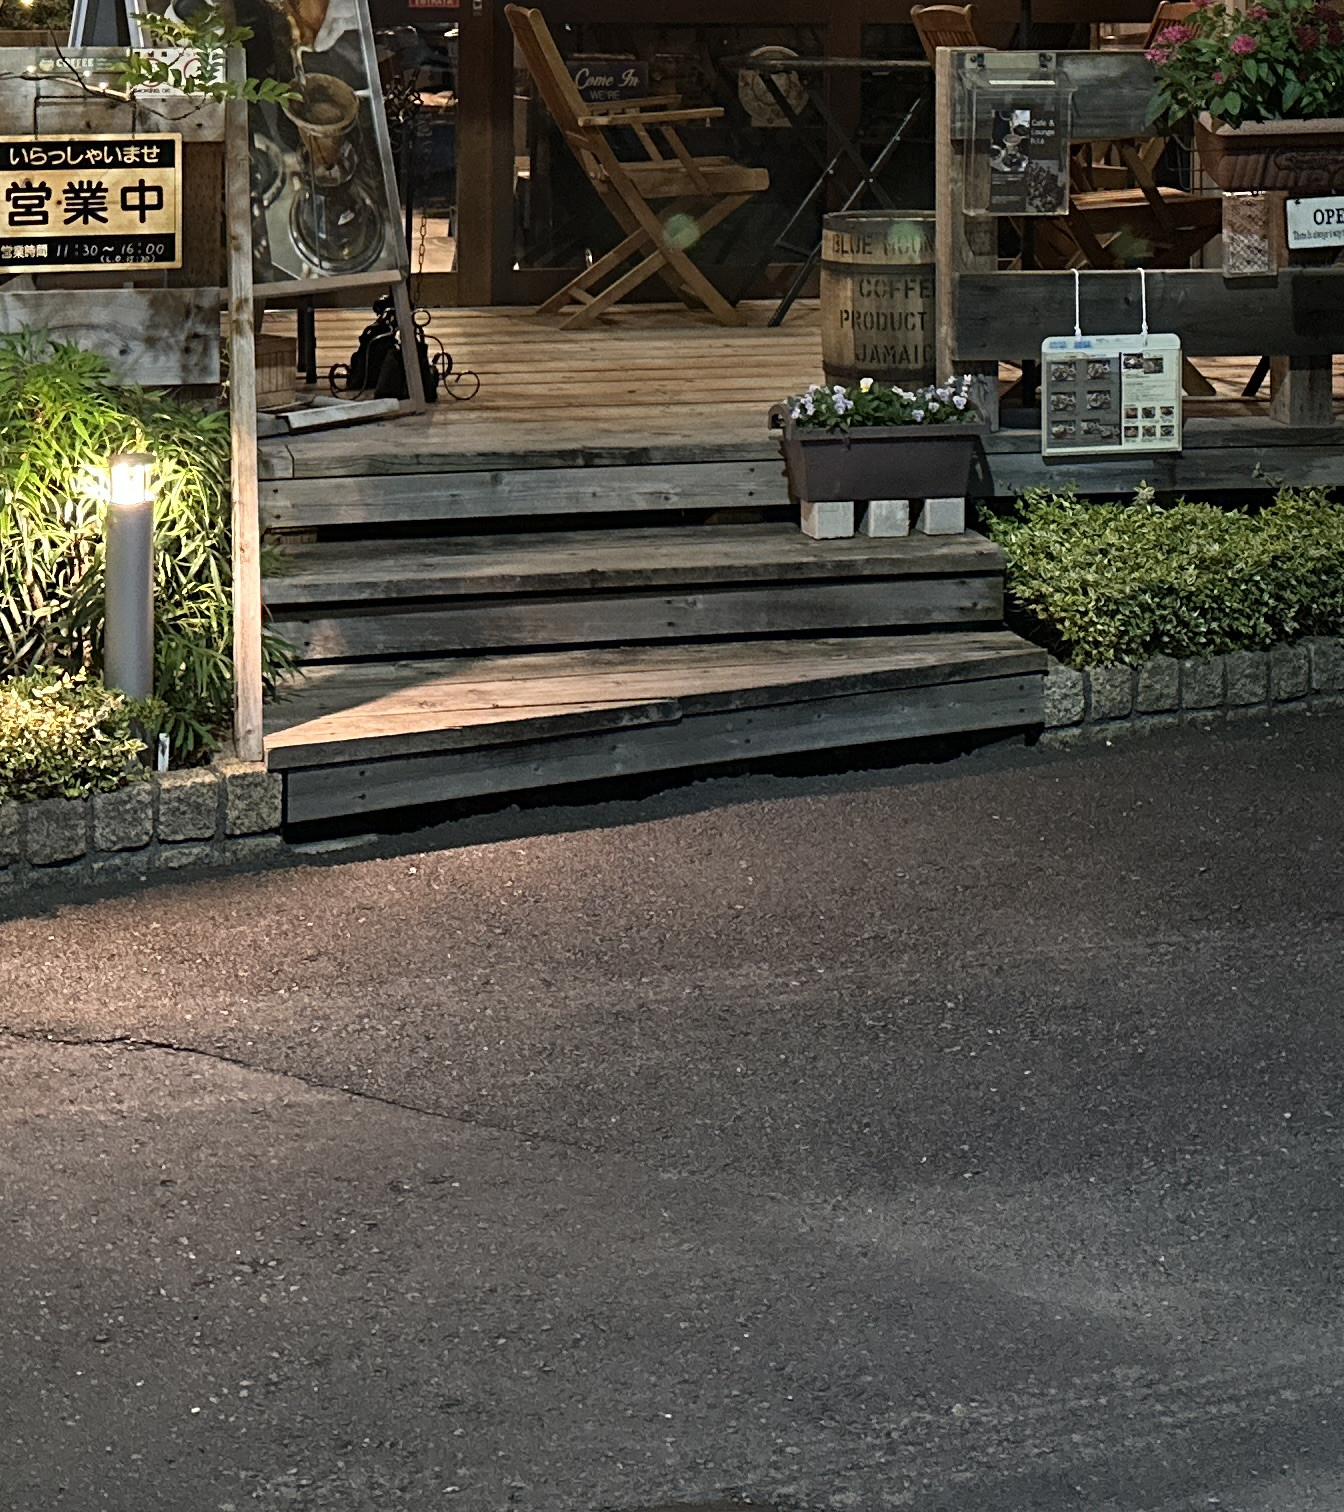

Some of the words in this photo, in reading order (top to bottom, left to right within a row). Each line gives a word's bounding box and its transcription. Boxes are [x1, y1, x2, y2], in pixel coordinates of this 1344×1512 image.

[575, 68, 615, 90] Come
[618, 69, 641, 88] In
[9, 145, 161, 165] いらっしゃいませ
[6, 178, 164, 227] 営業中
[0, 243, 48, 259] 営業時間
[832, 233, 873, 255] BLUE
[884, 233, 935, 256] MOUN
[859, 278, 935, 299] COFFE
[840, 309, 928, 331] PRODUCT
[856, 344, 933, 365] JAMAIC
